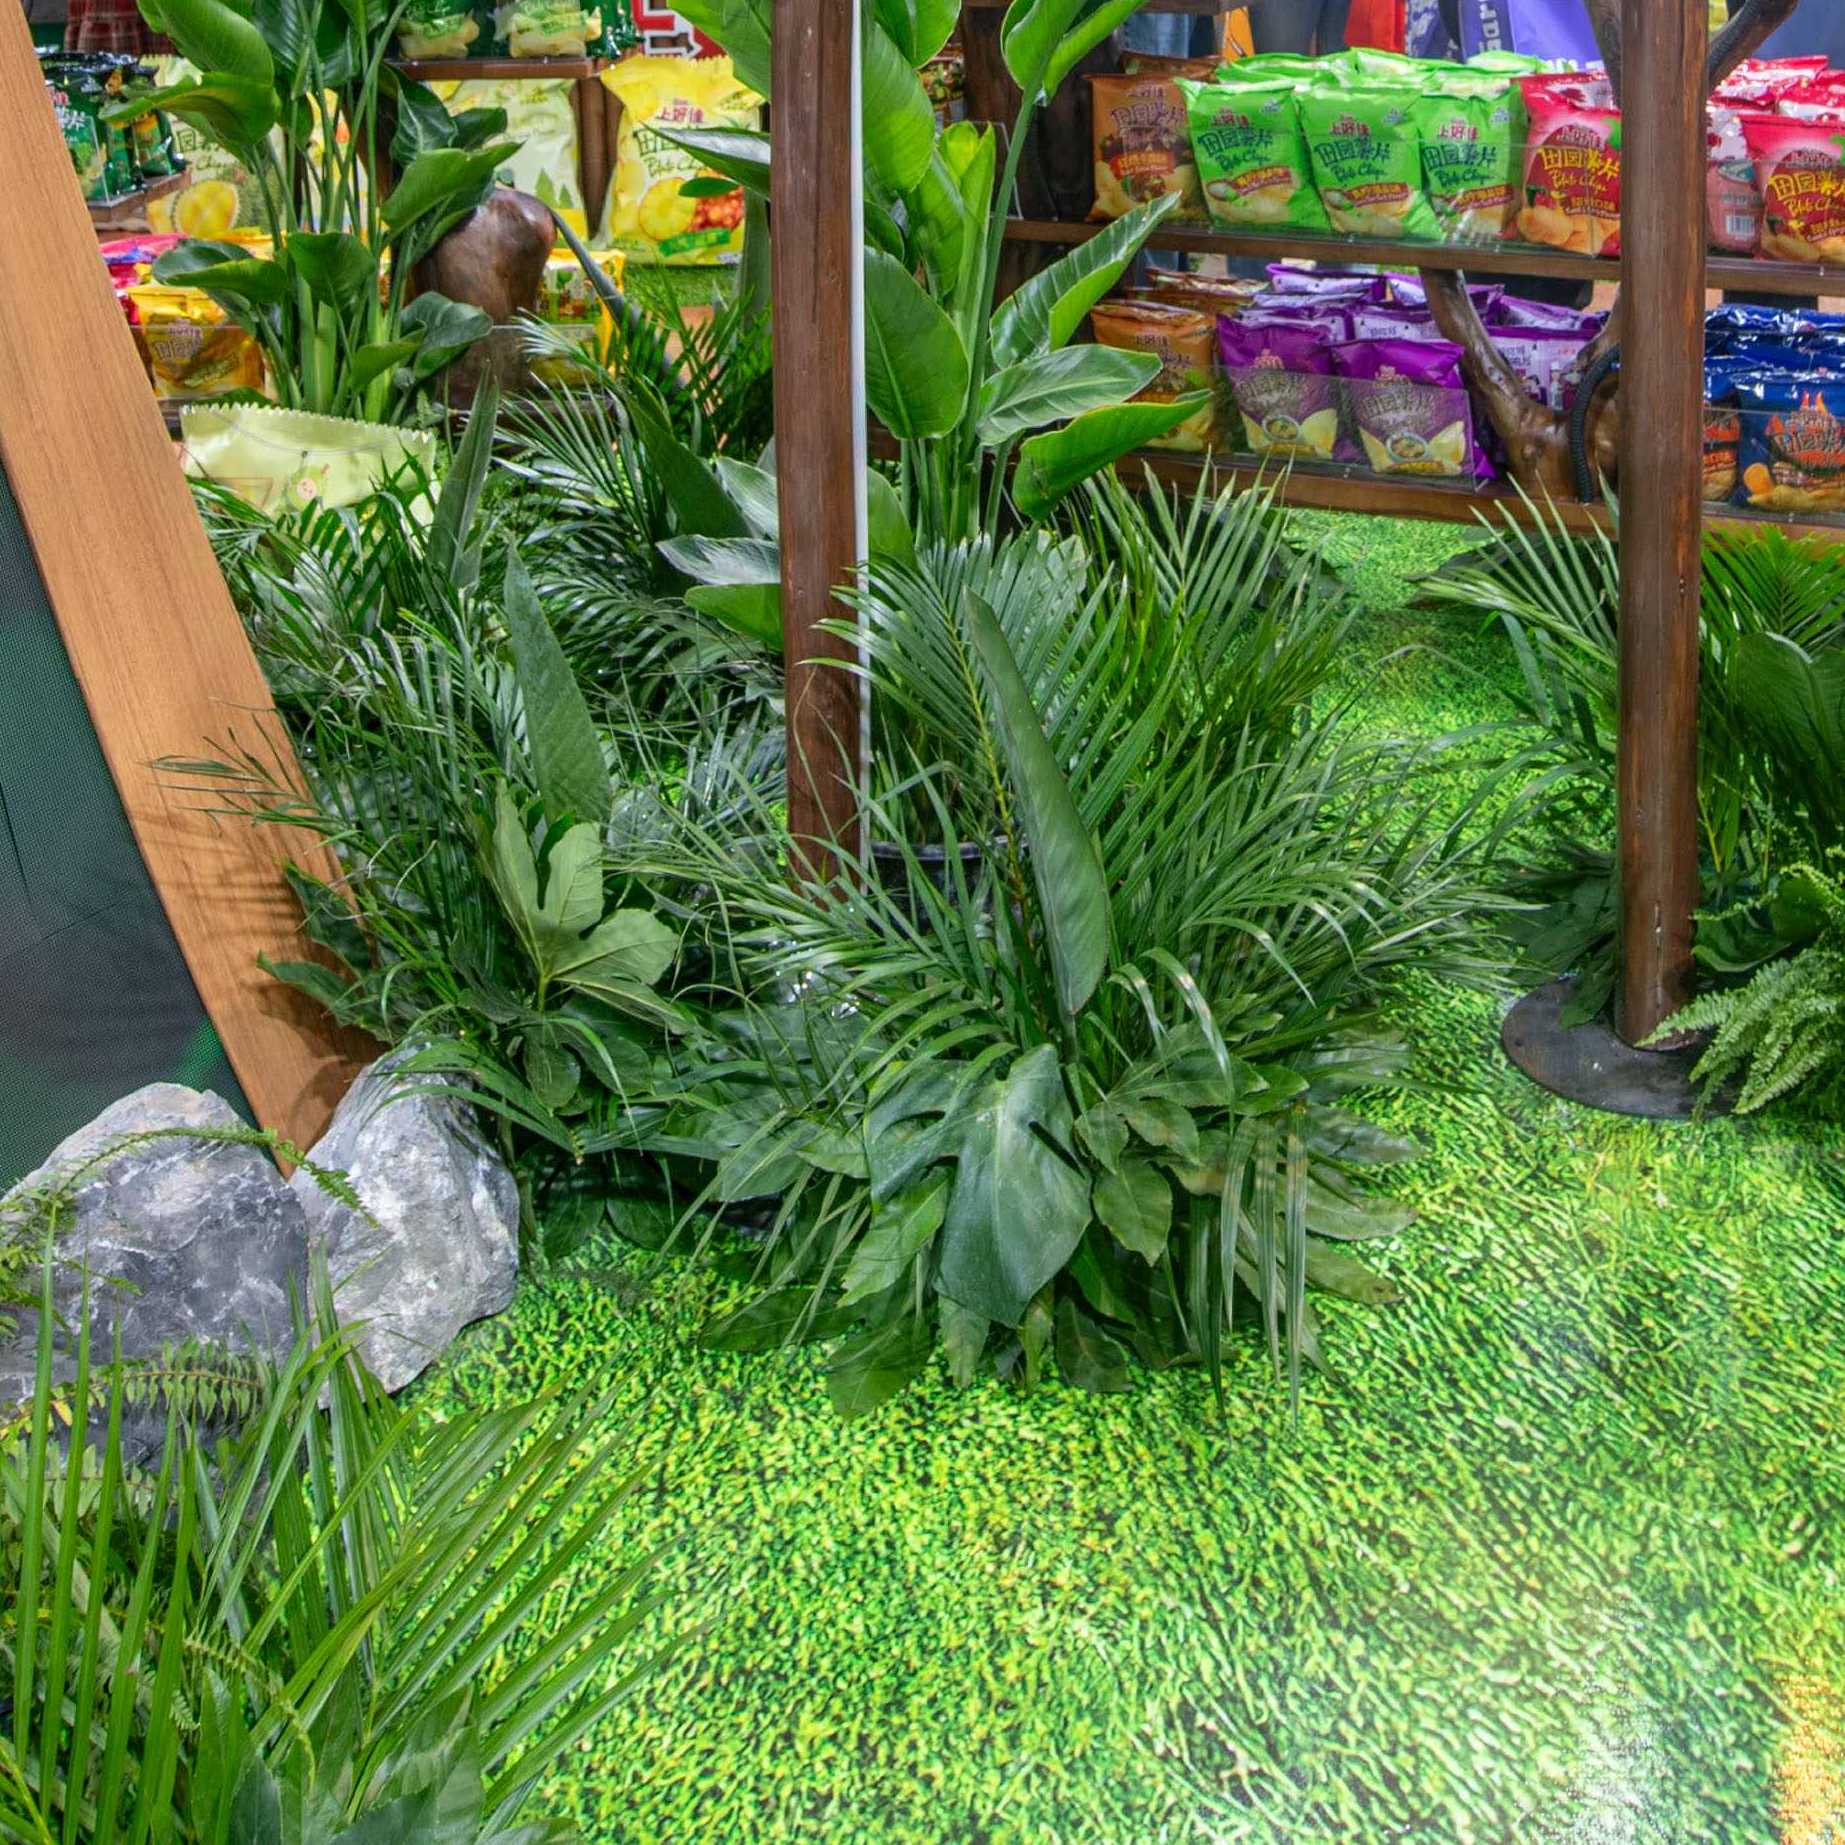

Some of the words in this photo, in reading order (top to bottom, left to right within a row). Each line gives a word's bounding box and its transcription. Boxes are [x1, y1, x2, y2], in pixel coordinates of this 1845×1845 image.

[1314, 137, 1390, 168] 田园薯片
[1421, 142, 1497, 172] 田园薯片
[1538, 147, 1620, 180] 田园薯片
